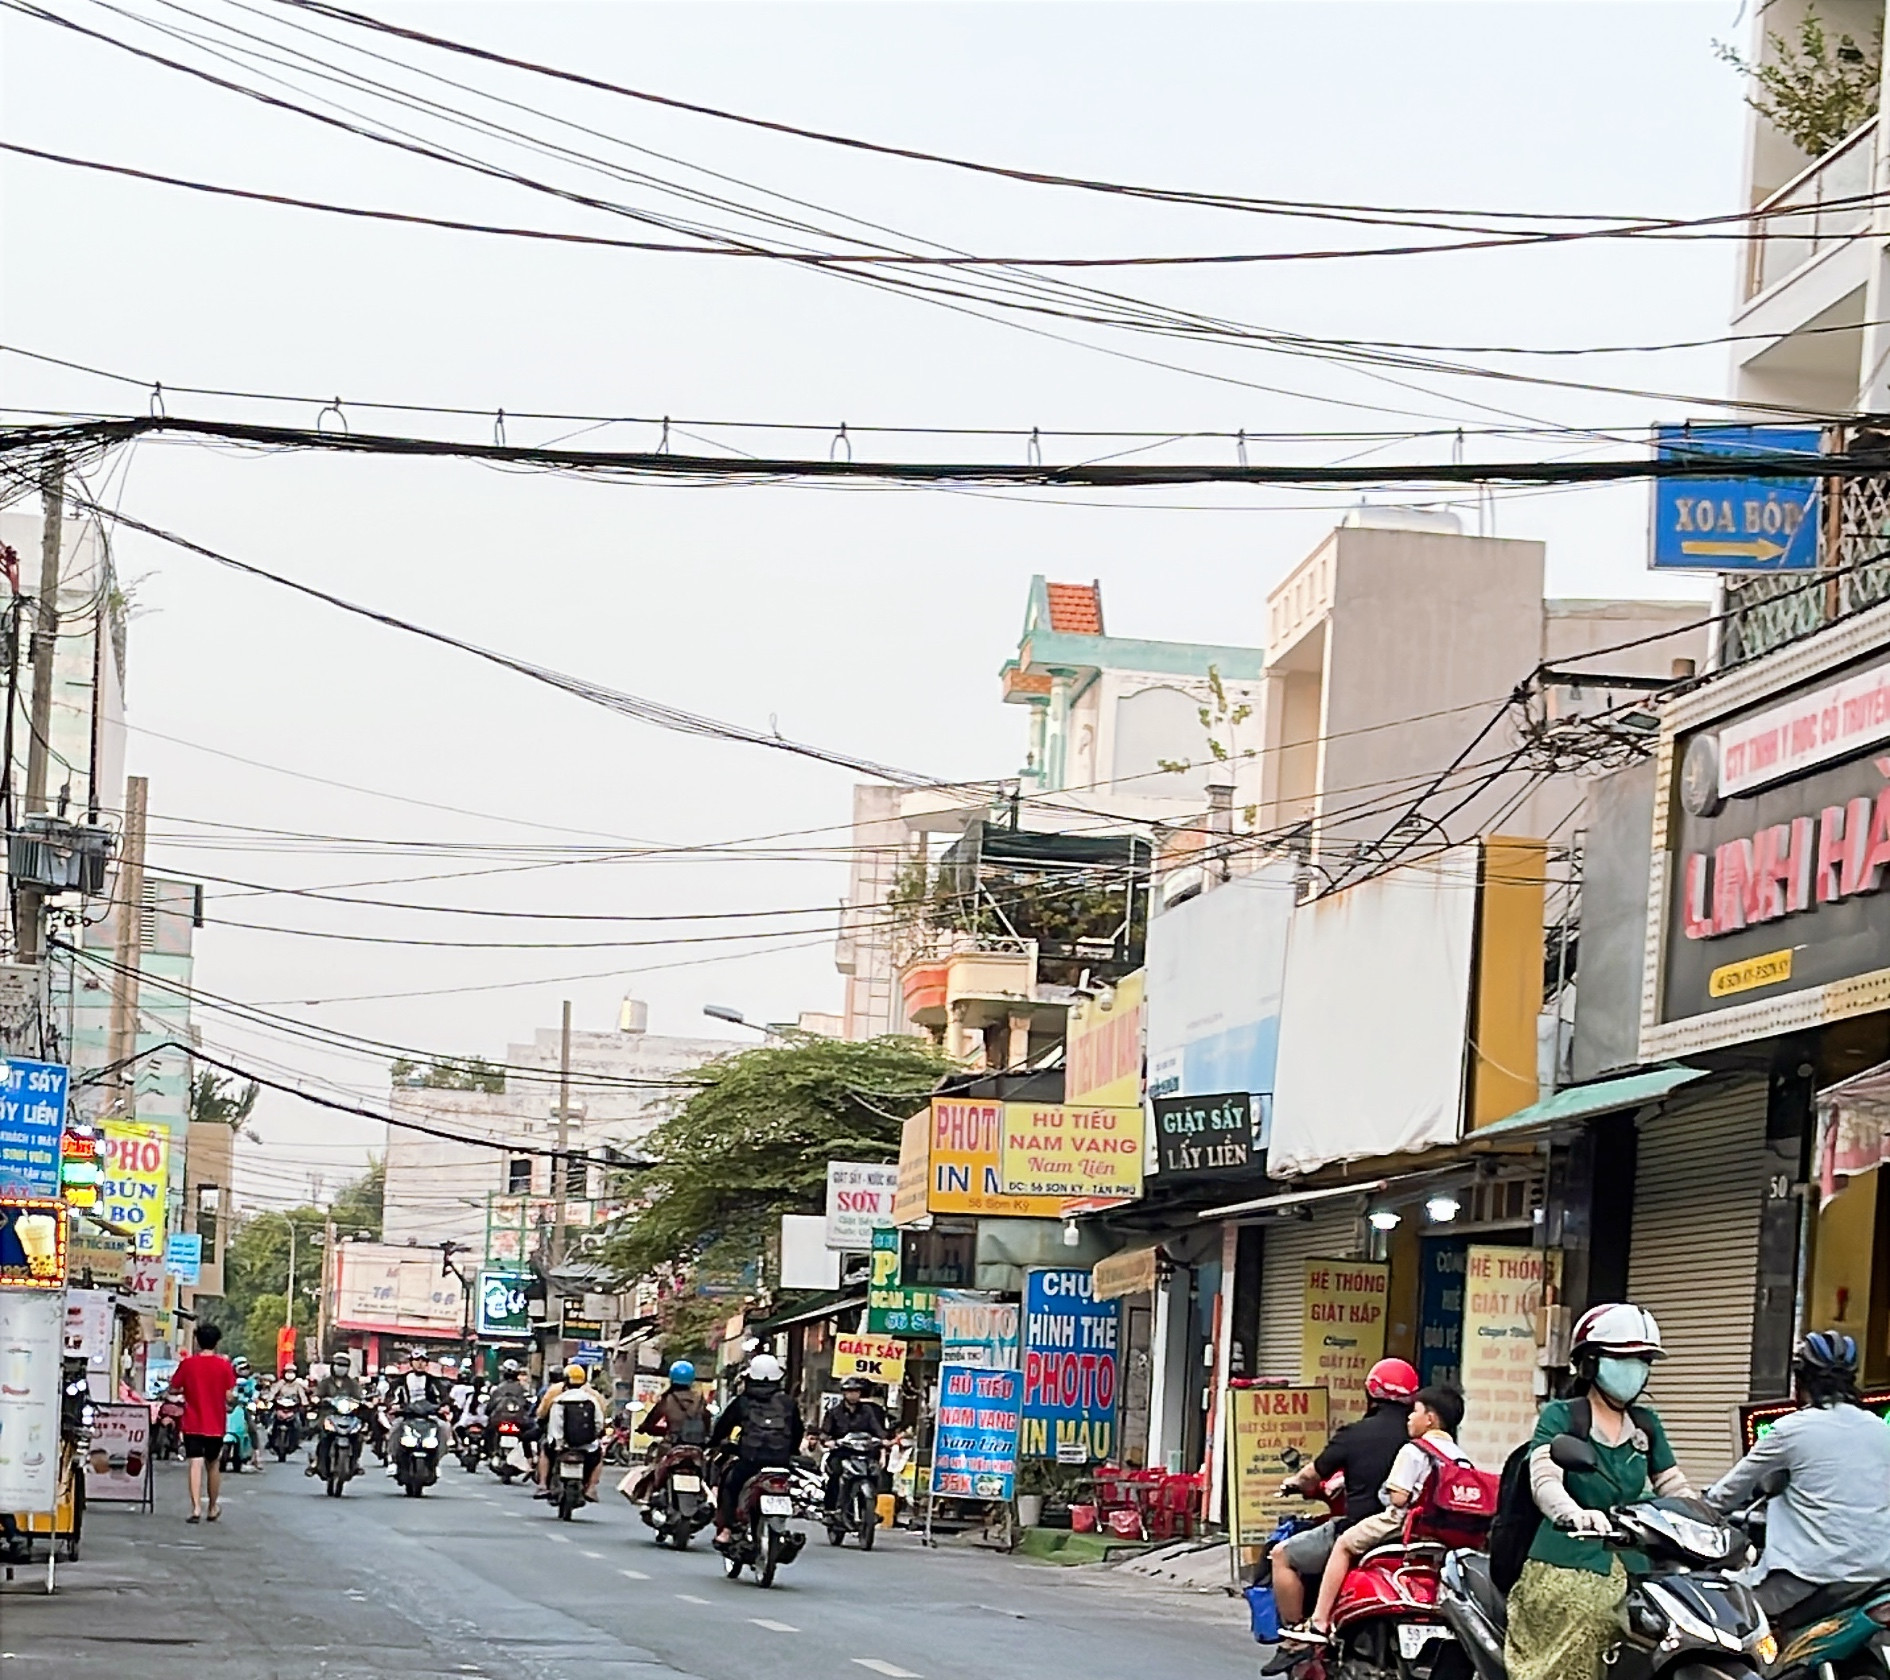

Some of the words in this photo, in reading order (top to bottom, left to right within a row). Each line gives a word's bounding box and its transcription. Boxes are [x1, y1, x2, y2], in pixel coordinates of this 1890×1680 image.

[1675, 499, 1736, 532] XOA
[1684, 816, 1814, 940] LINH
[28, 1068, 63, 1093] SẤY
[936, 1105, 999, 1152] PHOT
[1033, 1108, 1063, 1128] HỦ
[1072, 1109, 1116, 1130] TIẾU
[1163, 1105, 1205, 1137] GIẶT
[1211, 1098, 1244, 1130] SẤY
[1009, 1135, 1062, 1151] NAM
[1071, 1137, 1137, 1154] VANG
[1167, 1138, 1202, 1170] LẤY
[1028, 1157, 1072, 1174] Nam
[936, 1165, 970, 1192] IN
[1769, 1175, 1789, 1199] 50
[110, 1202, 145, 1223] BÒ
[837, 1189, 880, 1213] SƠN
[1042, 1272, 1100, 1304] CHỤ
[1335, 1268, 1386, 1293] THỐNG
[1515, 1291, 1537, 1316] HẤ
[945, 1305, 1017, 1340] PHOTO
[1029, 1304, 1075, 1347] HÌNH
[1080, 1304, 1118, 1350] THẺ
[856, 1360, 882, 1375] 9K
[1024, 1350, 1115, 1410] PHOTO
[1254, 1392, 1309, 1415] N&N
[940, 1406, 975, 1428] NAM
[978, 1409, 1017, 1431] VANG
[1022, 1418, 1047, 1455] IN
[1056, 1410, 1110, 1459] MÀU
